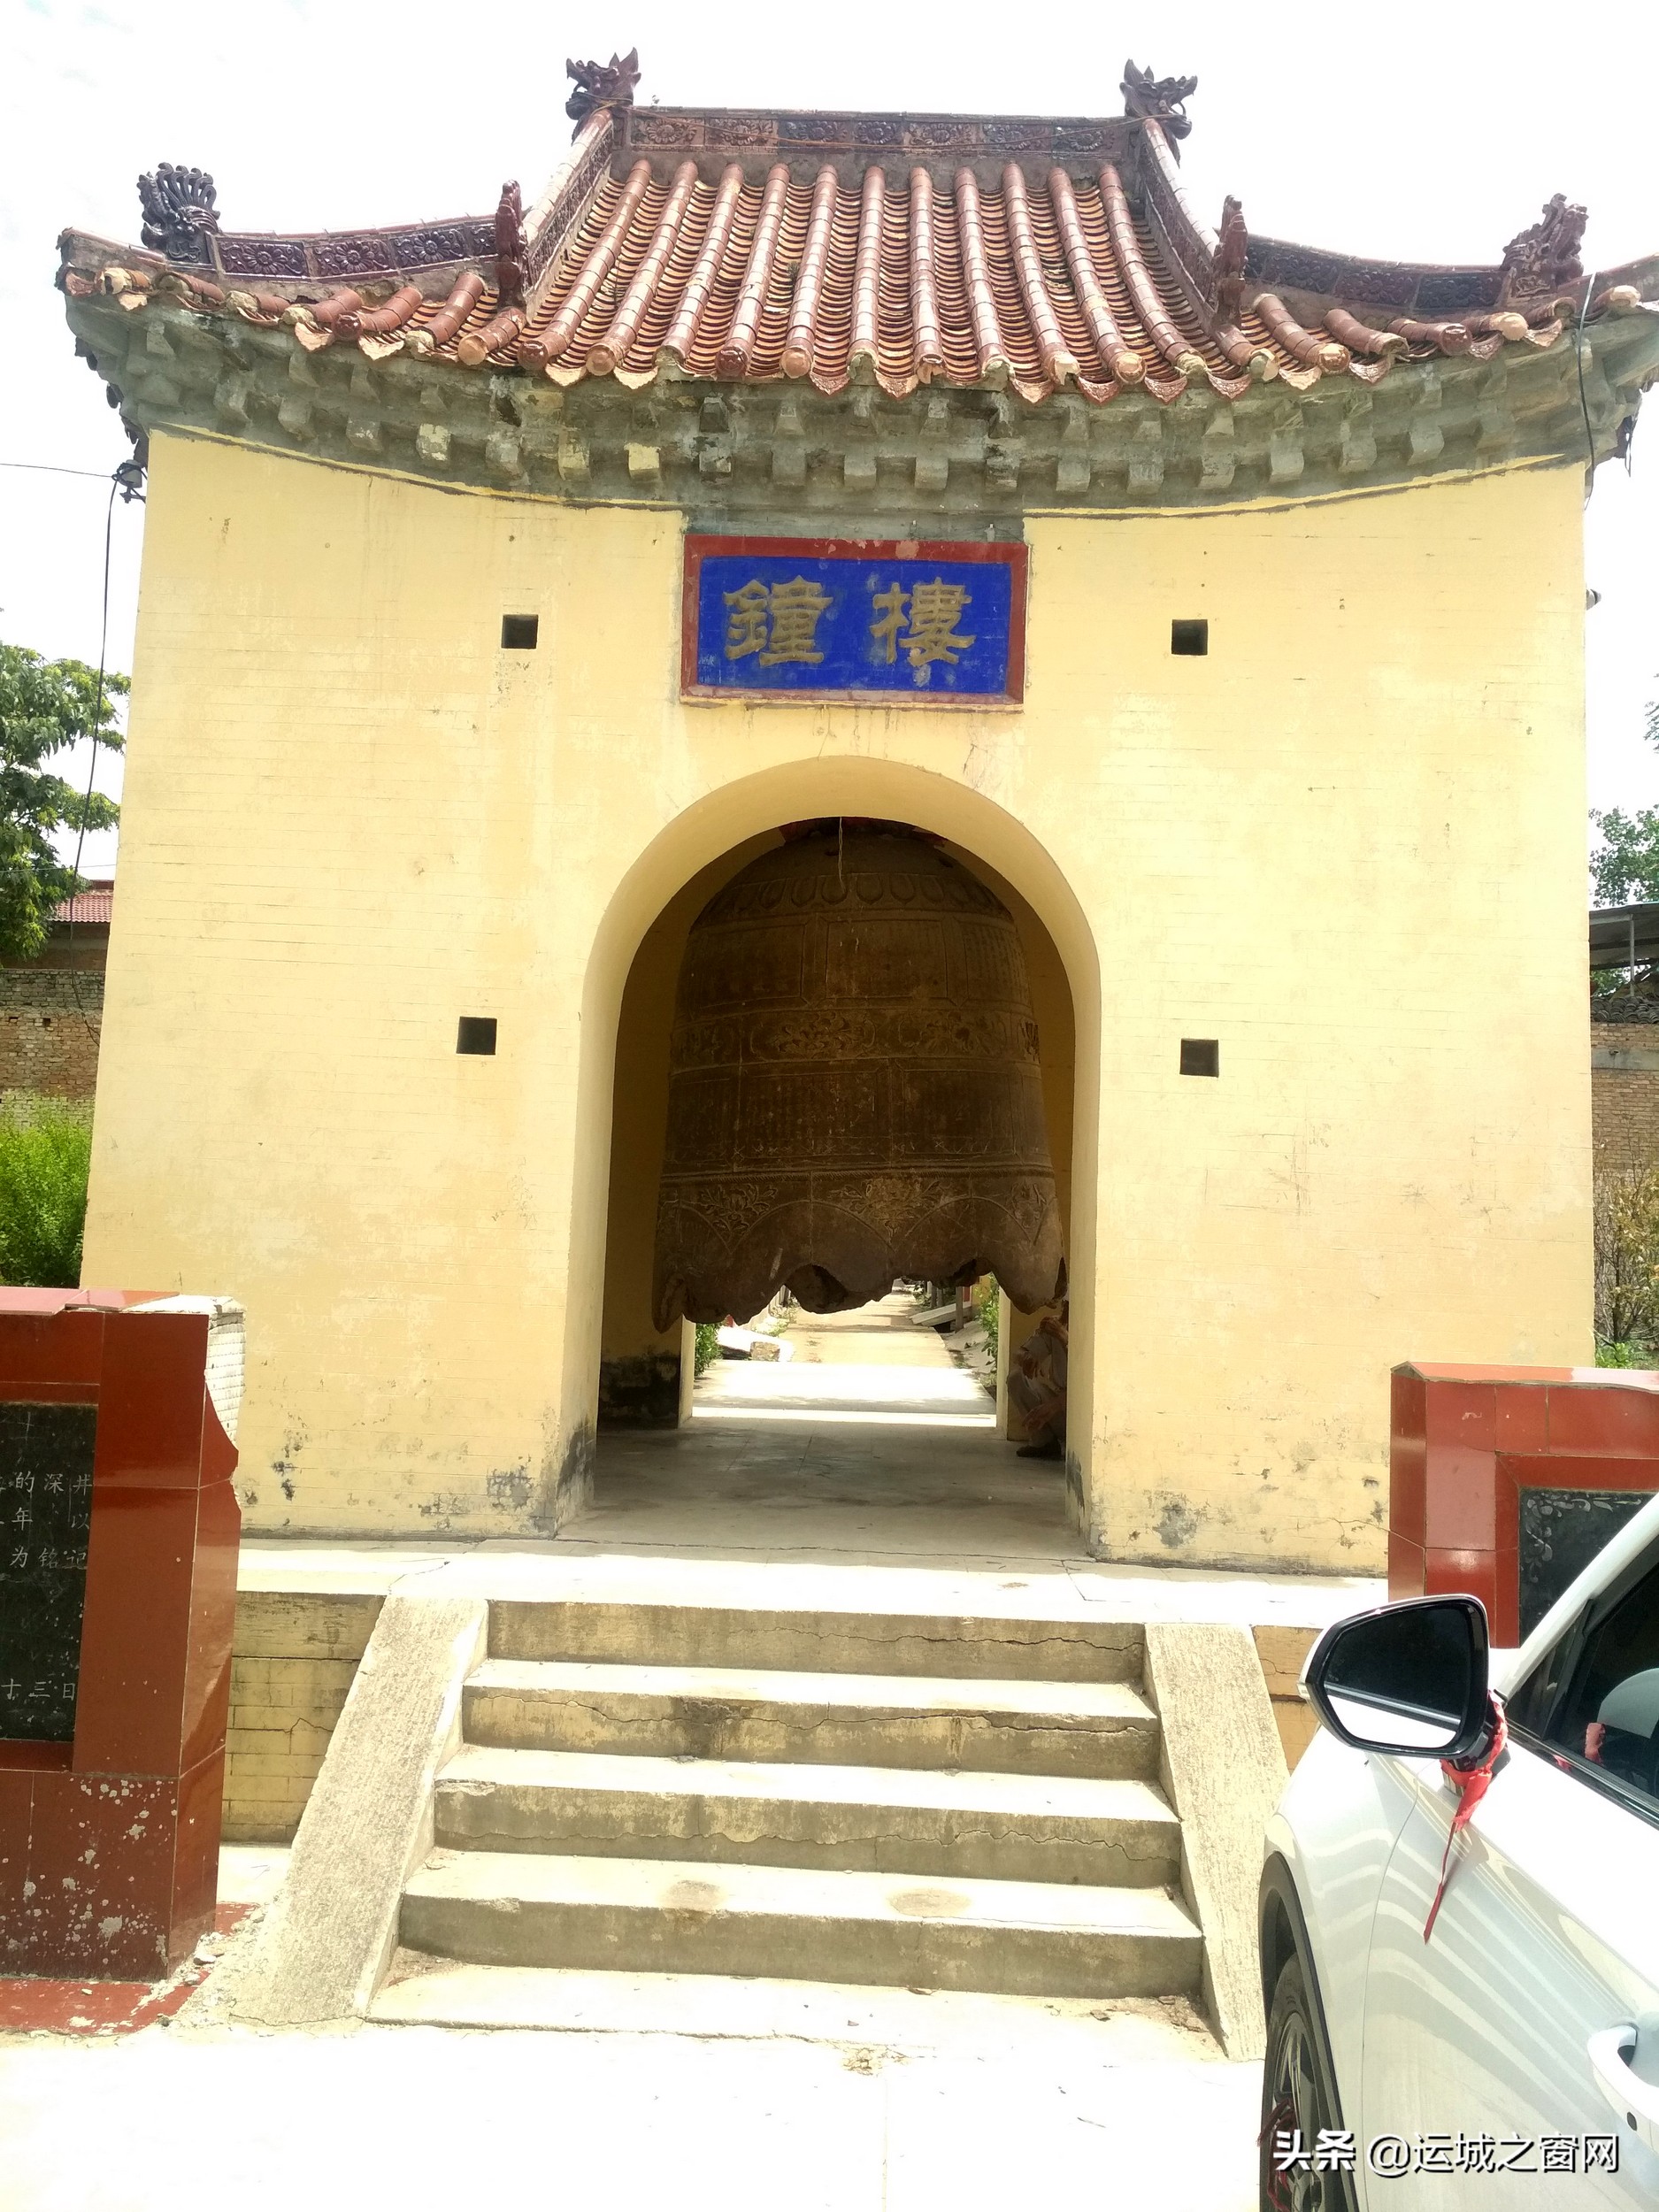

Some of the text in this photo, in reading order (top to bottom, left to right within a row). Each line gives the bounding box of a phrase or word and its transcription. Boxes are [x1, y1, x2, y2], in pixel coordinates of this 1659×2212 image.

[723, 575, 977, 668] 鐘樓
[0, 1507, 34, 1531] 年
[10, 1546, 87, 1569] 为铭记
[1, 1678, 76, 1701] 十三日
